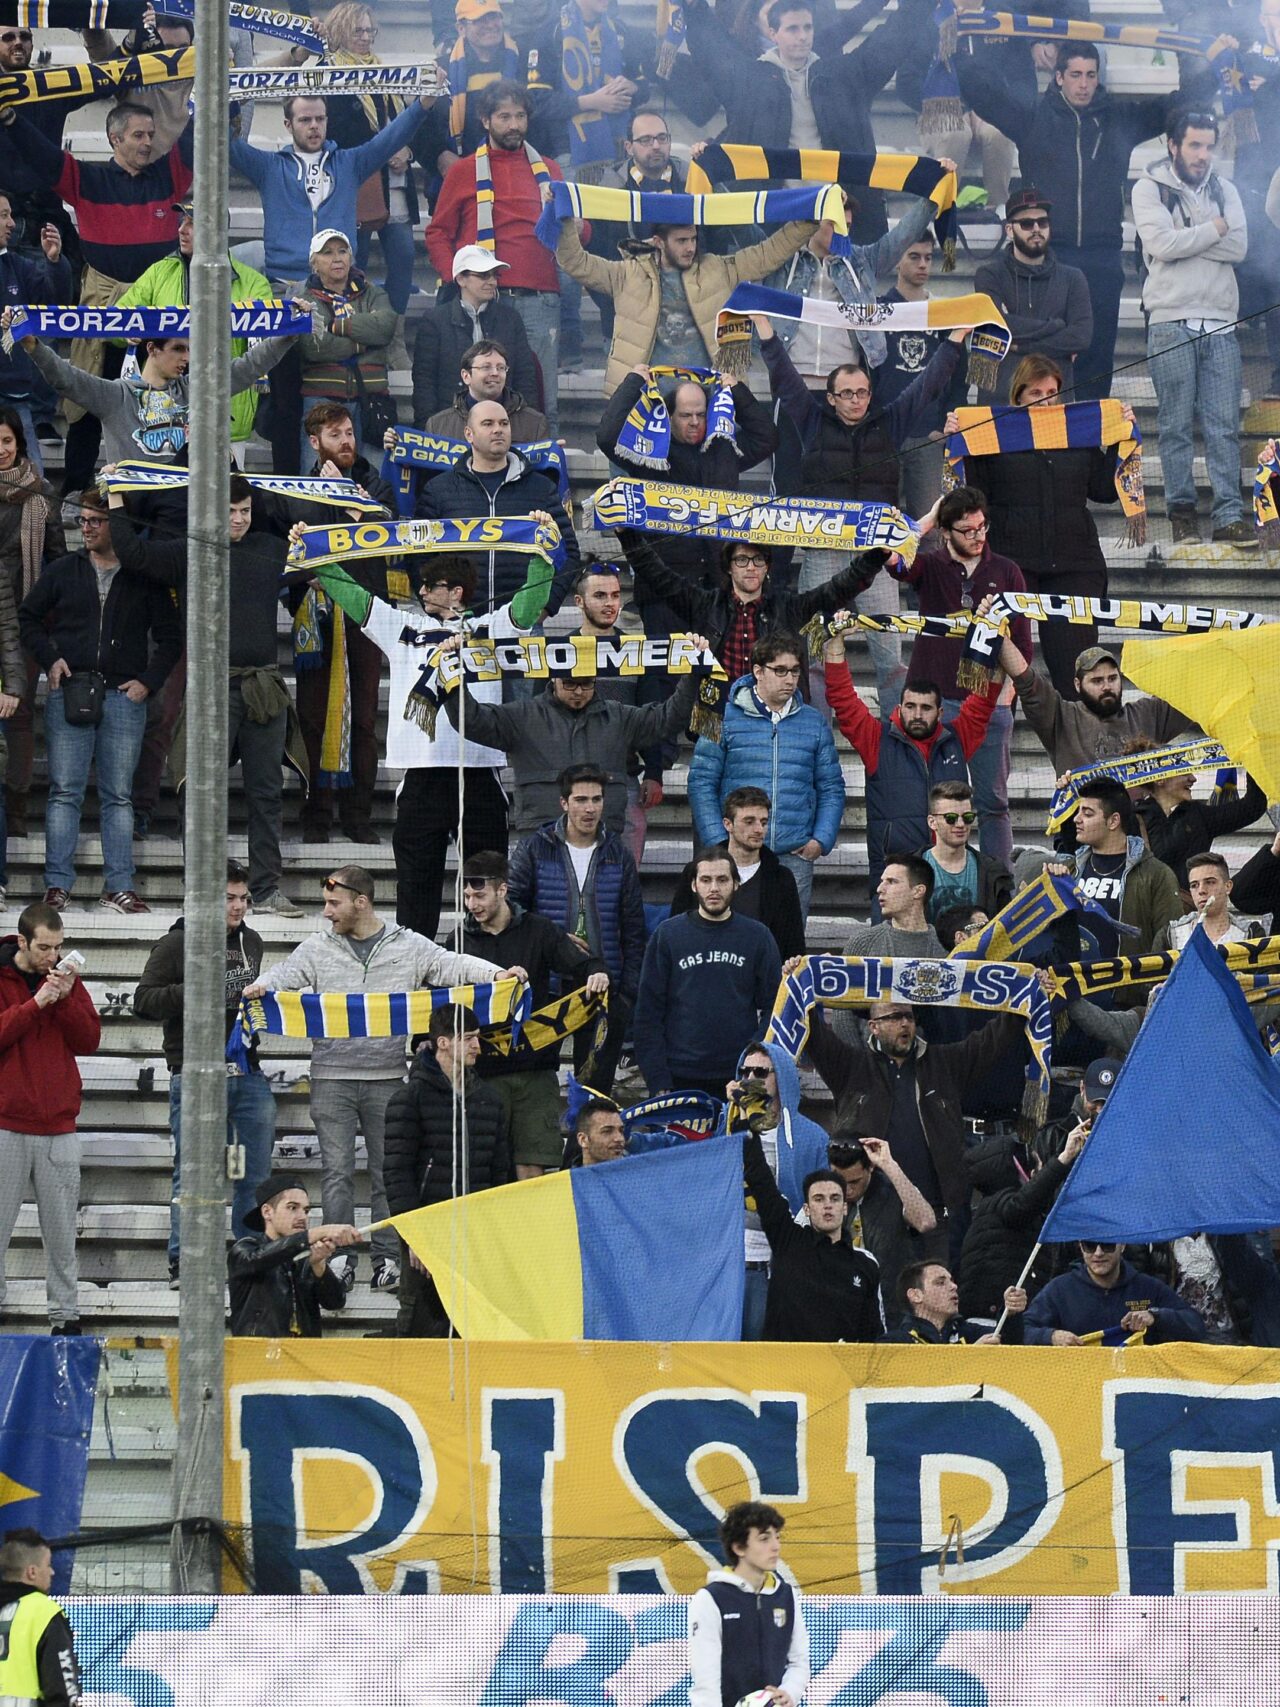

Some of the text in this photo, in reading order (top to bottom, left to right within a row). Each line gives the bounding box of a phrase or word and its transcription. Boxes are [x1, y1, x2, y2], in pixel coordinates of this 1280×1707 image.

[329, 67, 418, 85] PARMA
[40, 310, 282, 331] FORZA PAMA!
[722, 322, 745, 334] BOYS
[978, 336, 1000, 350] BOYS
[645, 482, 694, 495] CALCIO
[696, 487, 720, 499] DEL
[722, 490, 771, 504] STORIA
[789, 499, 842, 511] SECOLO
[843, 502, 863, 512] UN
[659, 495, 845, 536] PARMA F.C.
[645, 520, 854, 548] UN SECOLO DI STORIA DEL CALCIO
[679, 950, 746, 969] GAS JEANS
